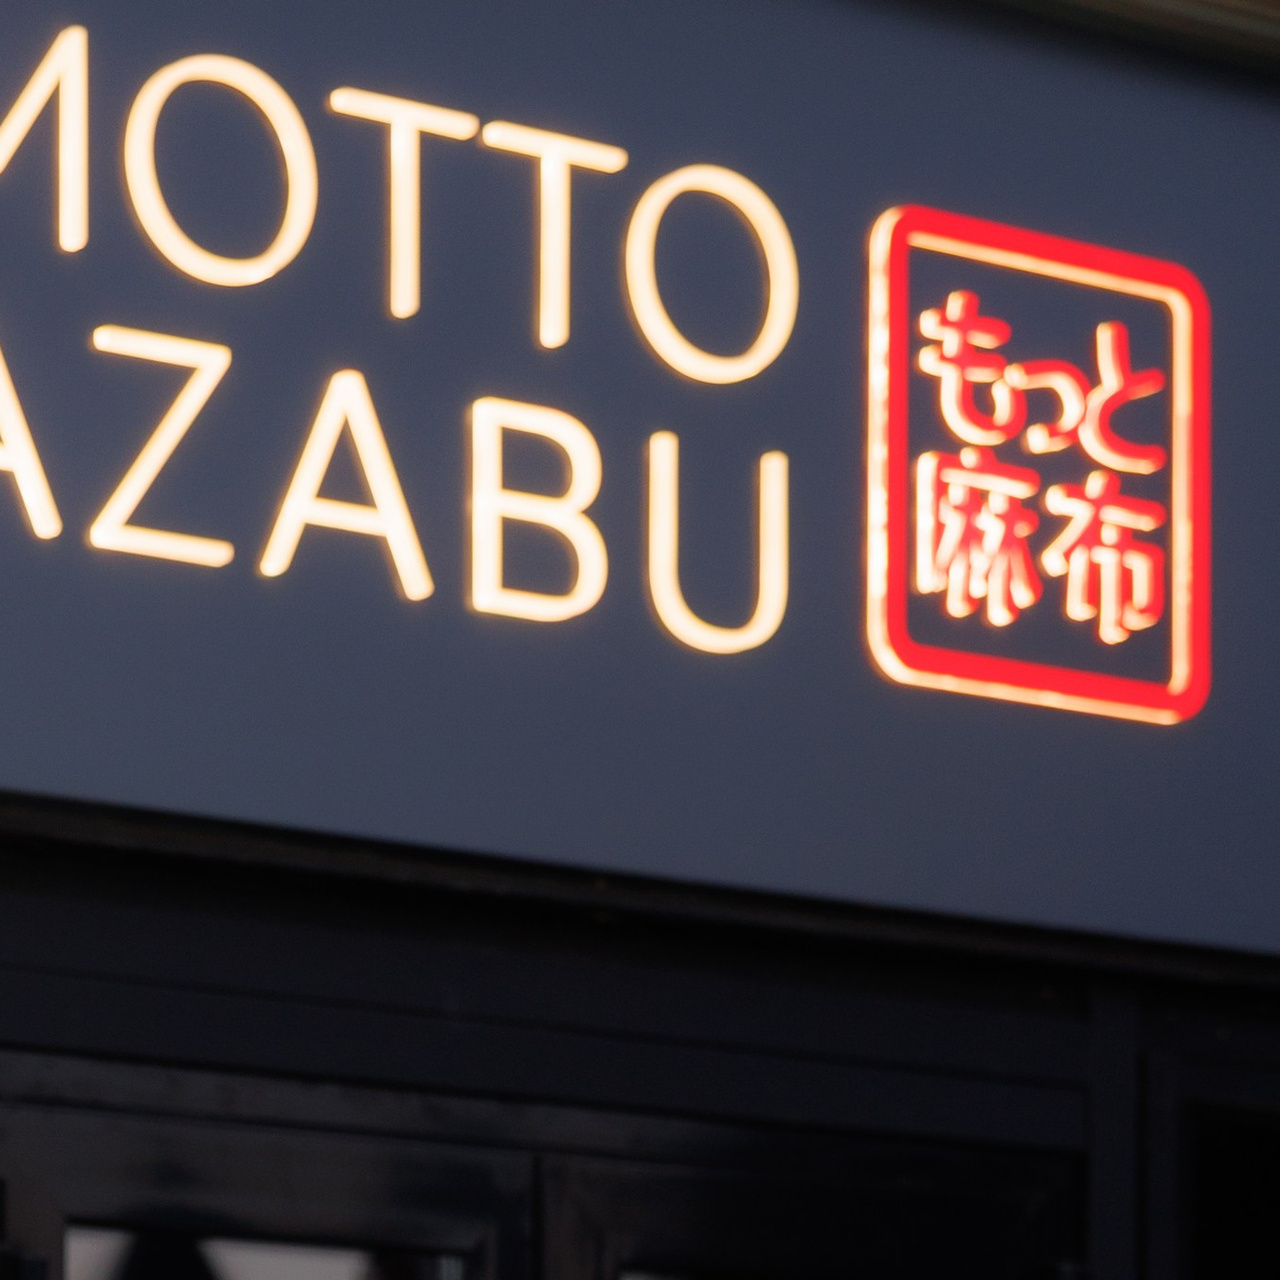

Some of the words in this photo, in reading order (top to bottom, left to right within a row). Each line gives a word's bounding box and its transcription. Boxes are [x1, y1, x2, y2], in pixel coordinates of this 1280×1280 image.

[919, 290, 1167, 475] もっと
[916, 446, 1167, 645] 麻布
